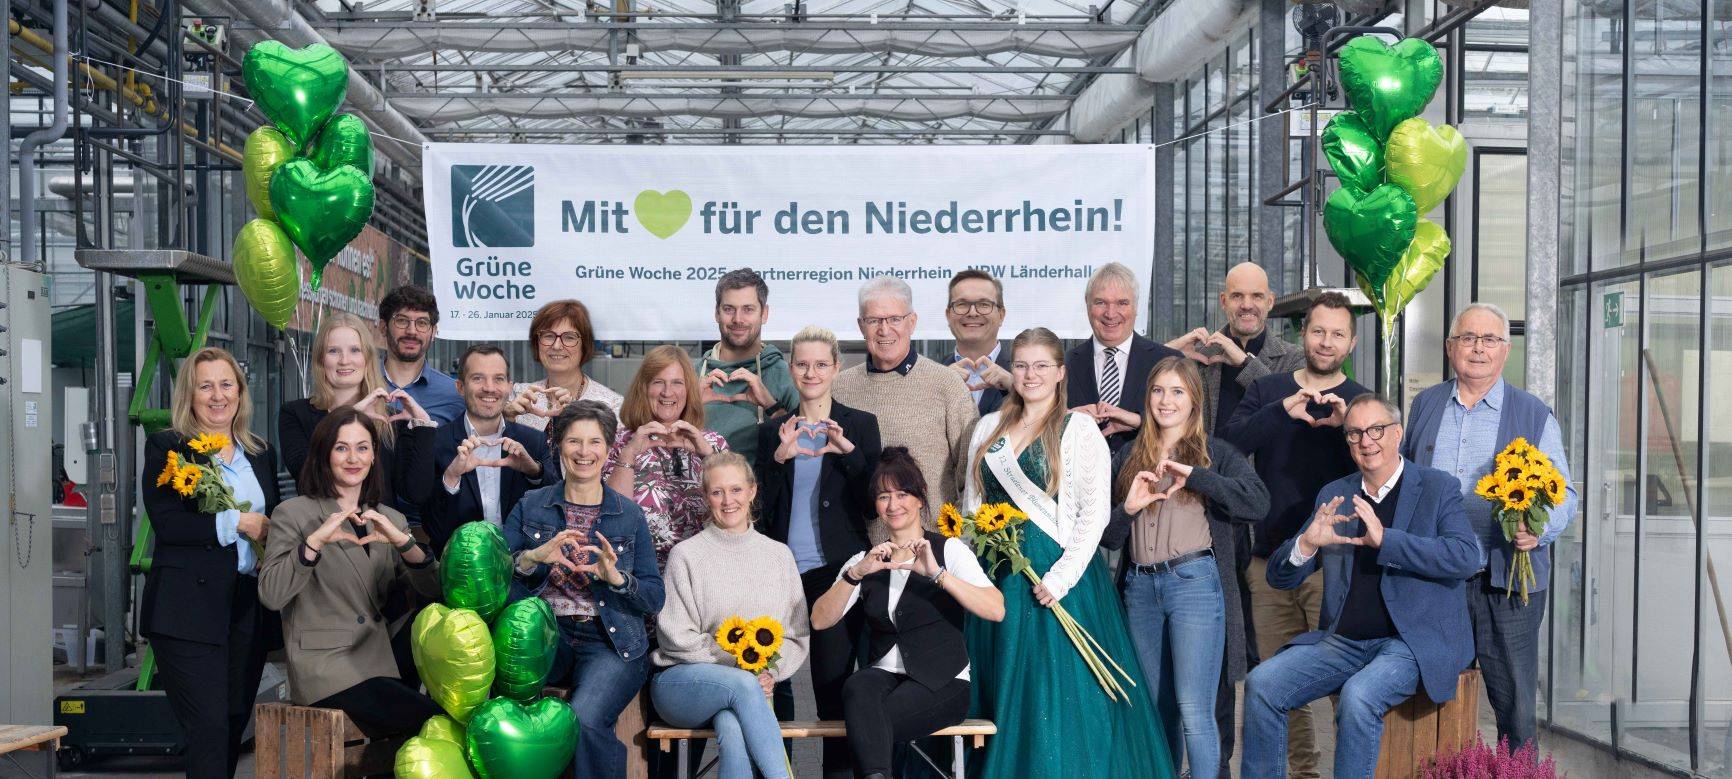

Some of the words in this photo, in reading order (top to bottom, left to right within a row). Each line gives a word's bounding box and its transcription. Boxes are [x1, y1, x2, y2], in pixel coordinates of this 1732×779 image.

[561, 200, 629, 233] Mit
[699, 201, 761, 234] für
[774, 202, 849, 234] den
[865, 199, 1123, 234] Niederrhein!
[456, 255, 532, 277] Grüne
[575, 265, 625, 279] Grüne
[628, 266, 682, 280] Woche
[686, 267, 727, 280] 2025
[754, 266, 853, 283] artnerregion
[1010, 265, 1097, 278] Länderhall
[453, 279, 536, 300] Woche
[450, 310, 460, 319] 17.
[468, 310, 481, 319] 26.
[483, 310, 513, 319] Januar
